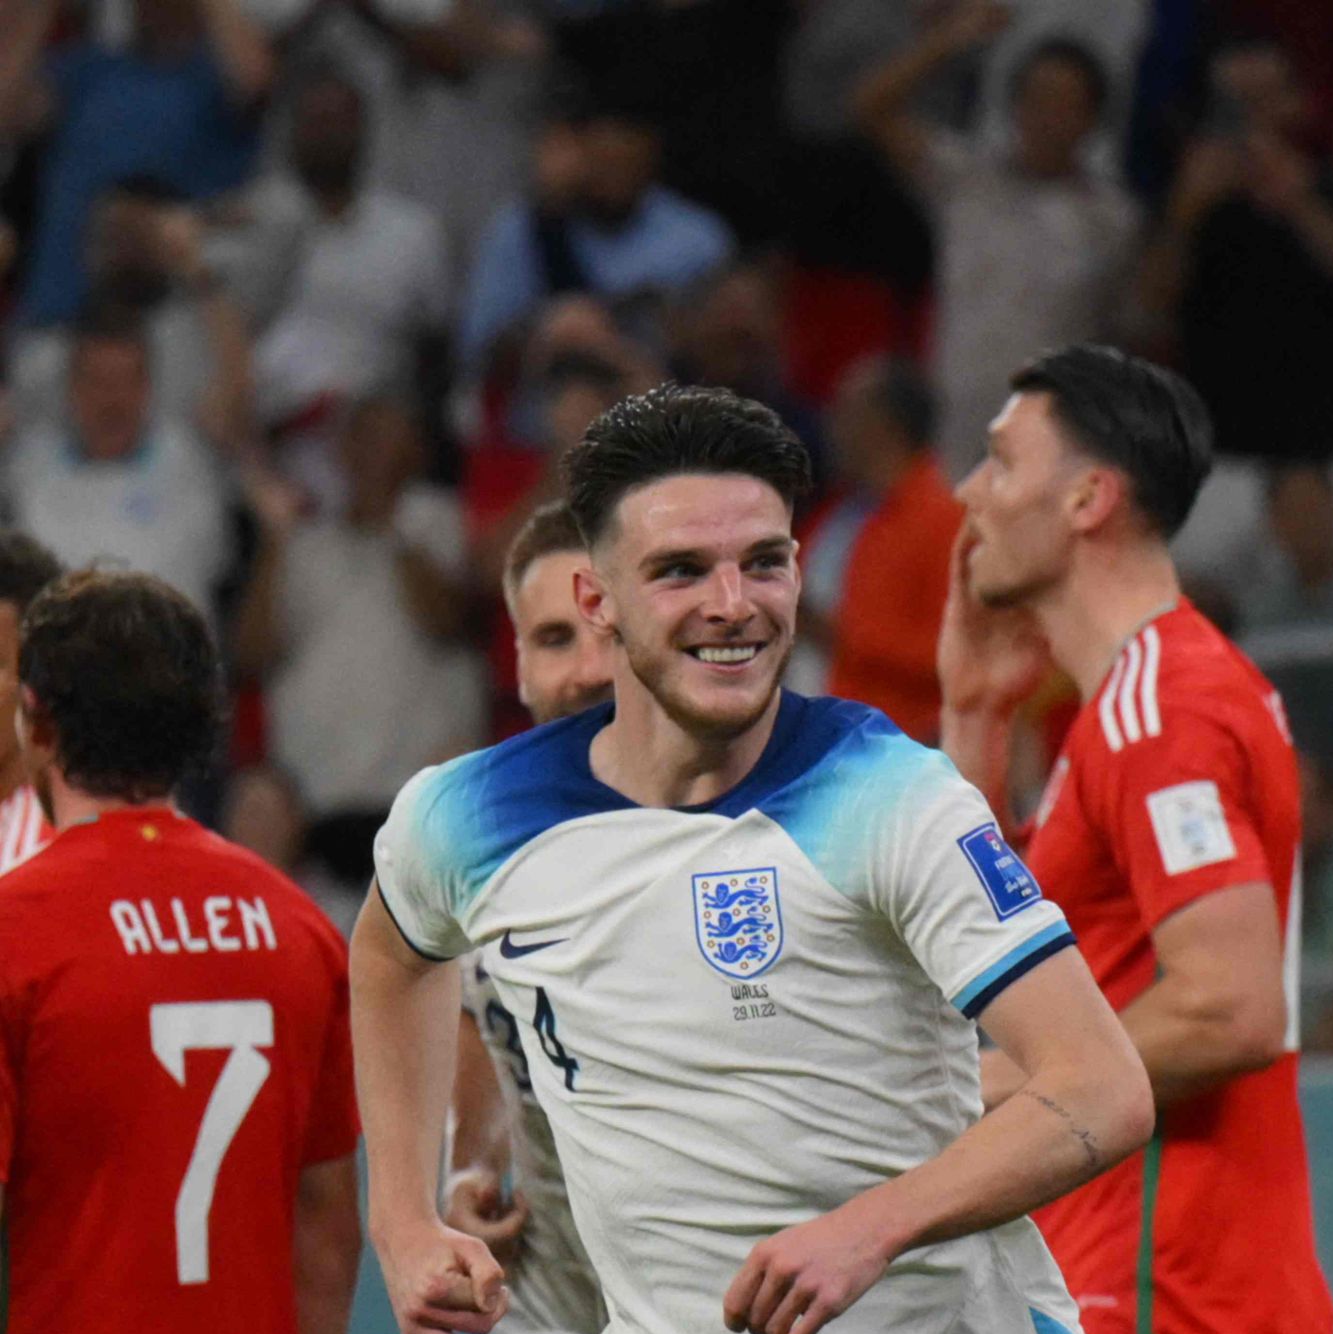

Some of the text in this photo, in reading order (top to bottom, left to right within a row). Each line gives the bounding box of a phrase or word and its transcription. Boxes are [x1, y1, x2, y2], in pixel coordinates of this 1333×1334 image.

[109, 896, 277, 956] ALLEN
[730, 984, 769, 1000] WALES
[533, 986, 580, 1092] 4
[150, 999, 274, 1284] 7
